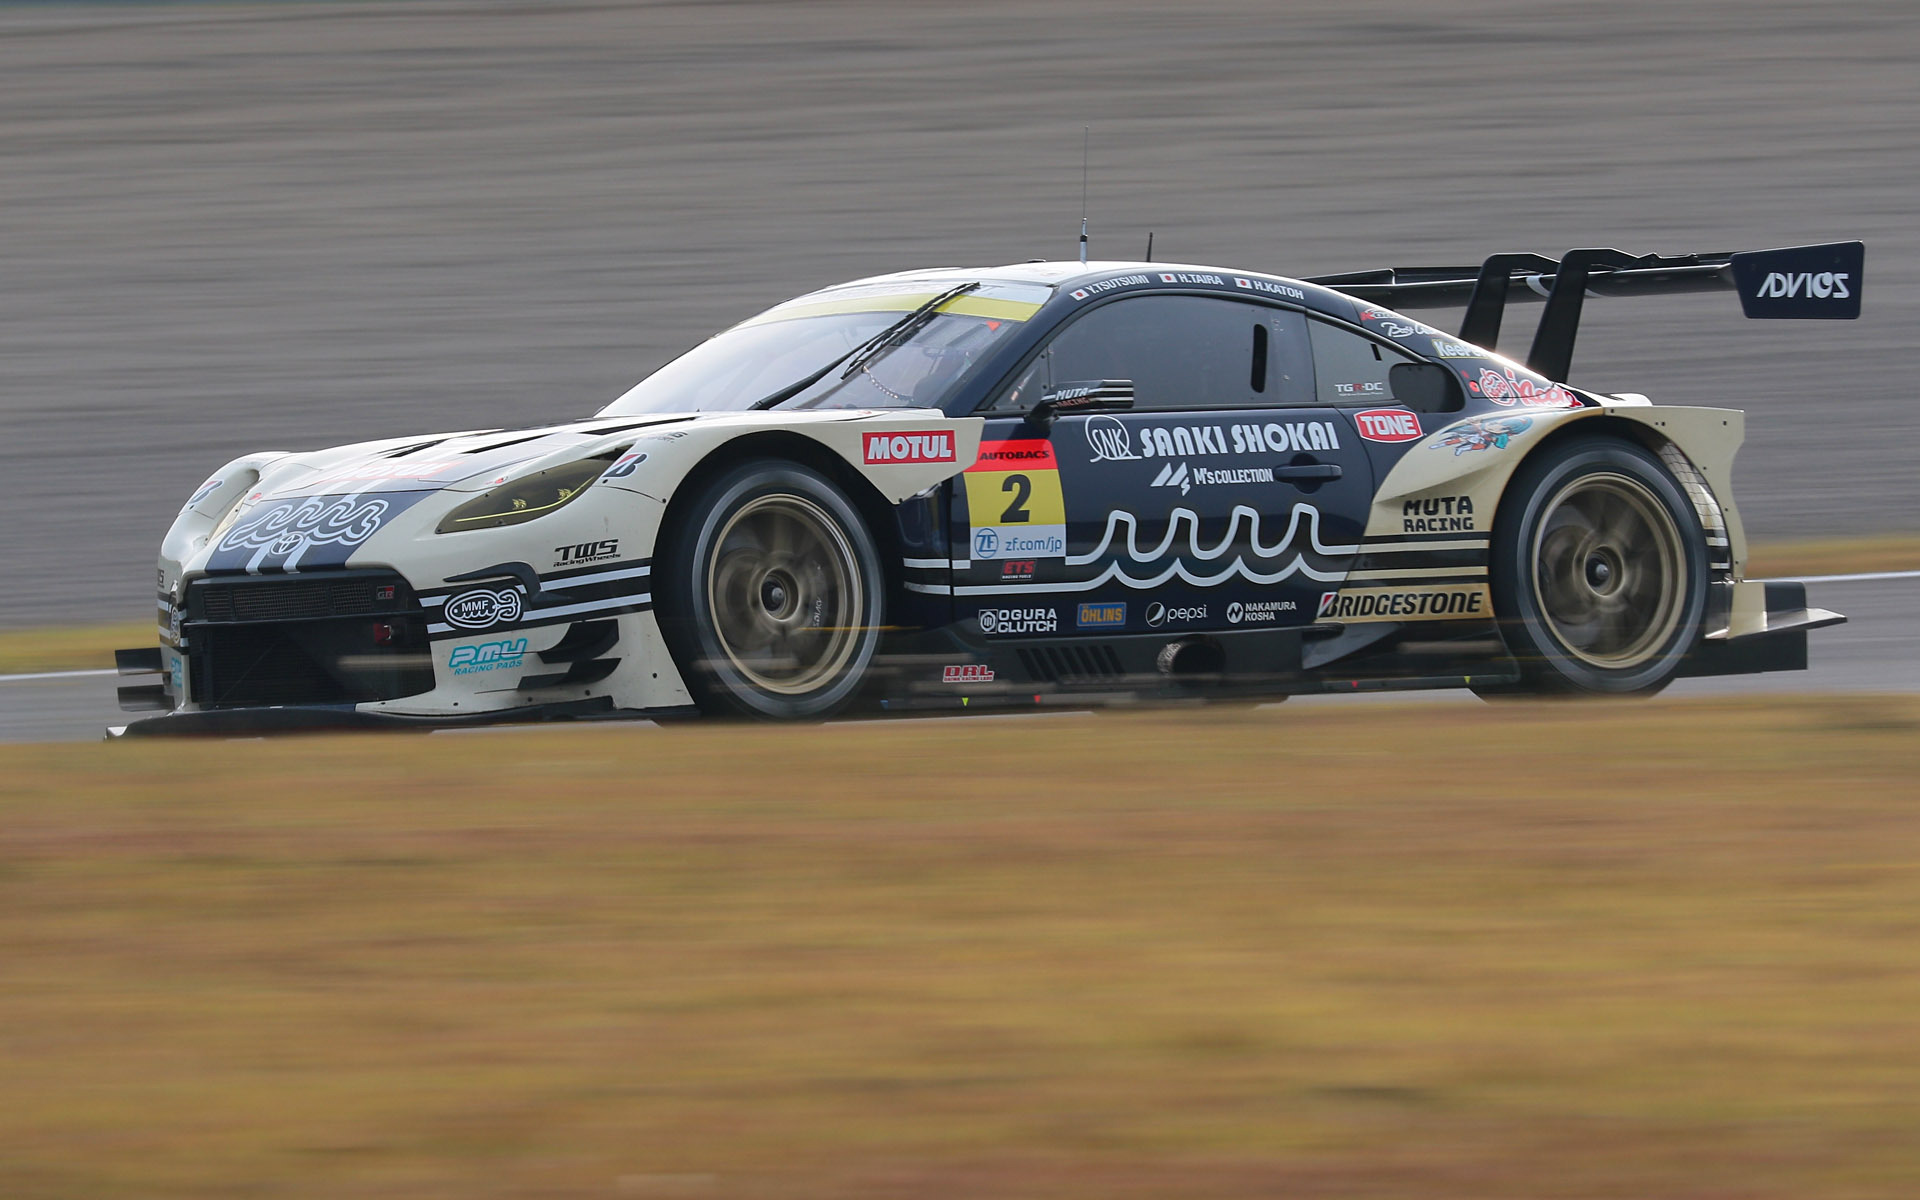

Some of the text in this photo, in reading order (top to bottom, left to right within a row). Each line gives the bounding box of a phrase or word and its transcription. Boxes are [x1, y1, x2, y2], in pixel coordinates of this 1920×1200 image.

[1085, 274, 1150, 295] Y.TSUTSUMI
[1179, 273, 1224, 286] H.TAIRA
[1756, 272, 1850, 298] ADVICS
[1253, 280, 1304, 300] H.KATOH
[1056, 387, 1089, 401] MUTA
[1361, 415, 1416, 436] TONE
[867, 435, 952, 460] MOTUL
[1140, 421, 1340, 458] SANKI SHOKAI
[979, 450, 1050, 461] AUTOBACS
[1000, 474, 1032, 523] 2
[1403, 496, 1473, 516] MUTA
[1403, 517, 1474, 532] RACING
[555, 539, 619, 561] TWS
[976, 532, 998, 554] ZF
[1006, 536, 1063, 552] zf.com/jp
[1003, 560, 1035, 574] ETS
[462, 599, 489, 613] MMF
[1167, 604, 1207, 622] pepsi
[1245, 601, 1297, 612] NAKAMURA
[1318, 591, 1483, 618] BRIDGESTONE
[998, 608, 1057, 621] OGURA
[1081, 605, 1123, 623] ÖHLINS
[1245, 611, 1275, 622] KOSHA
[997, 620, 1057, 633] CLUTCH
[454, 659, 523, 676] RACING PADS
[944, 665, 993, 677] DRL
